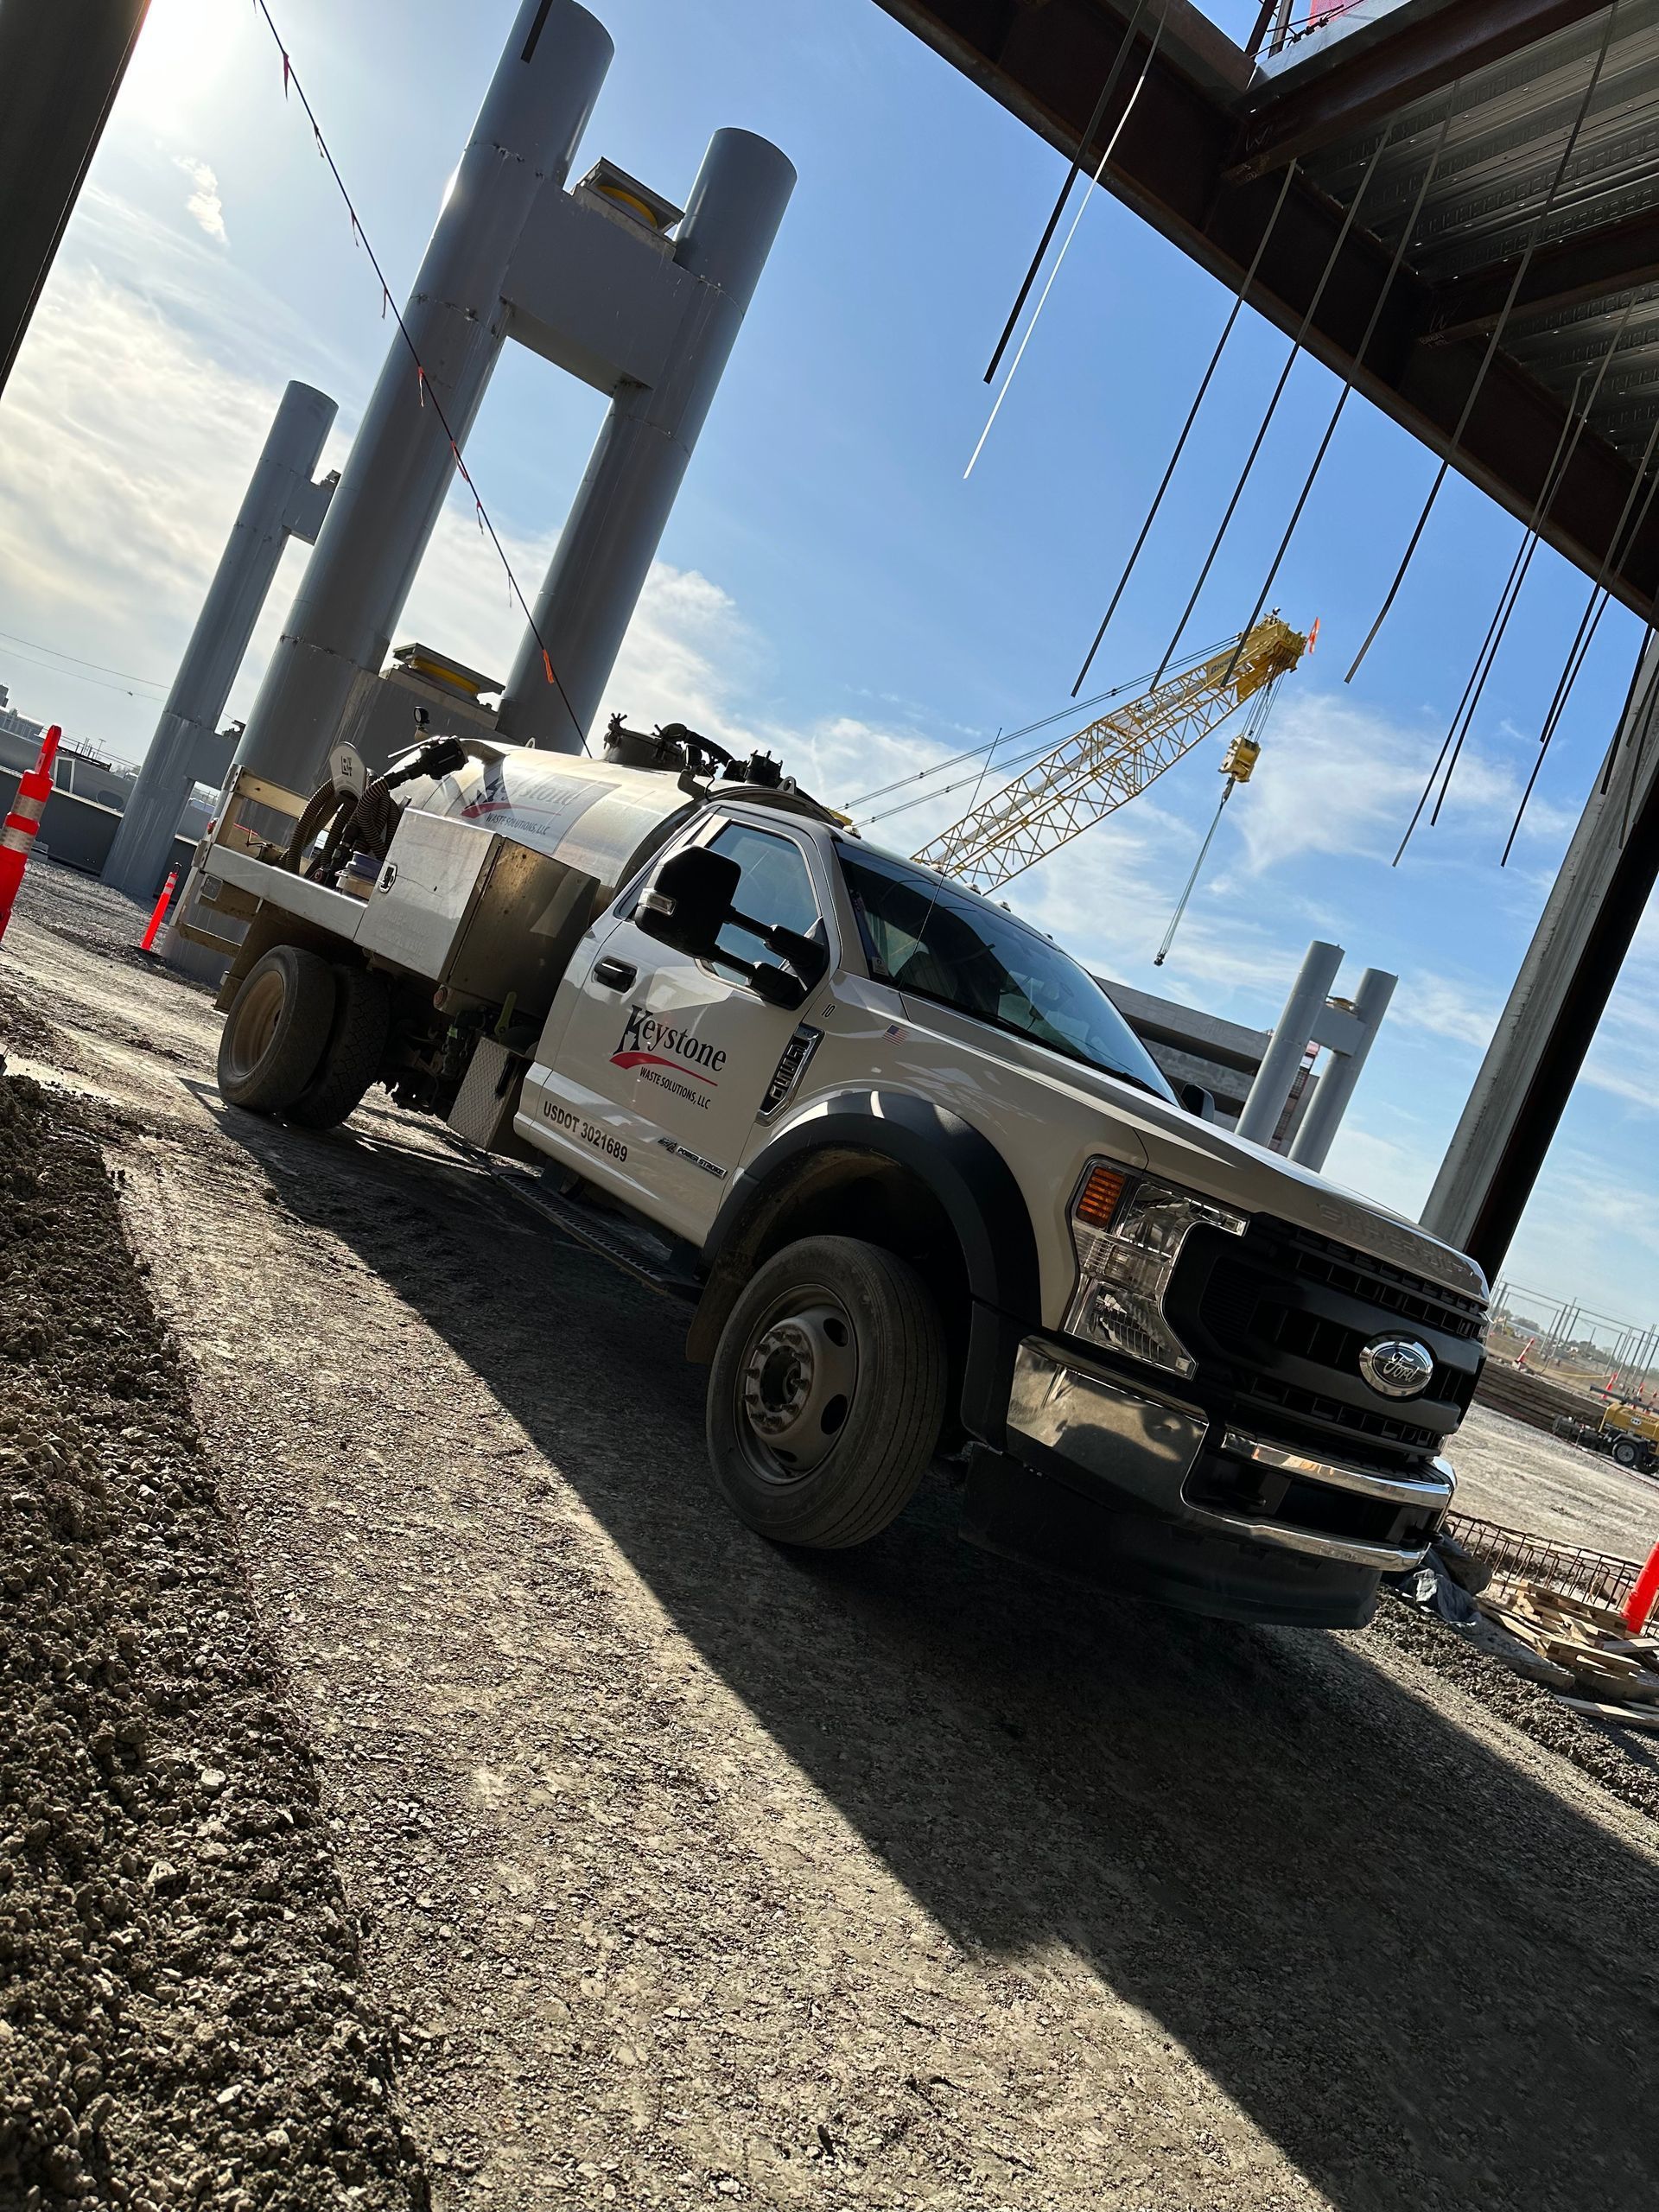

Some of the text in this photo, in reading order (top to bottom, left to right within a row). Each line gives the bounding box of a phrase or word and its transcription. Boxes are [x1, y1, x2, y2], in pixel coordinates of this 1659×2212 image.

[613, 1004, 727, 1071] Keystone
[640, 1066, 710, 1109] WASTE SOLUTIONS, LLC
[543, 1101, 628, 1162] USDOT 3021689
[677, 1147, 699, 1163] POWER
[698, 1158, 725, 1176] STROKE
[1382, 1351, 1421, 1382] Ford
